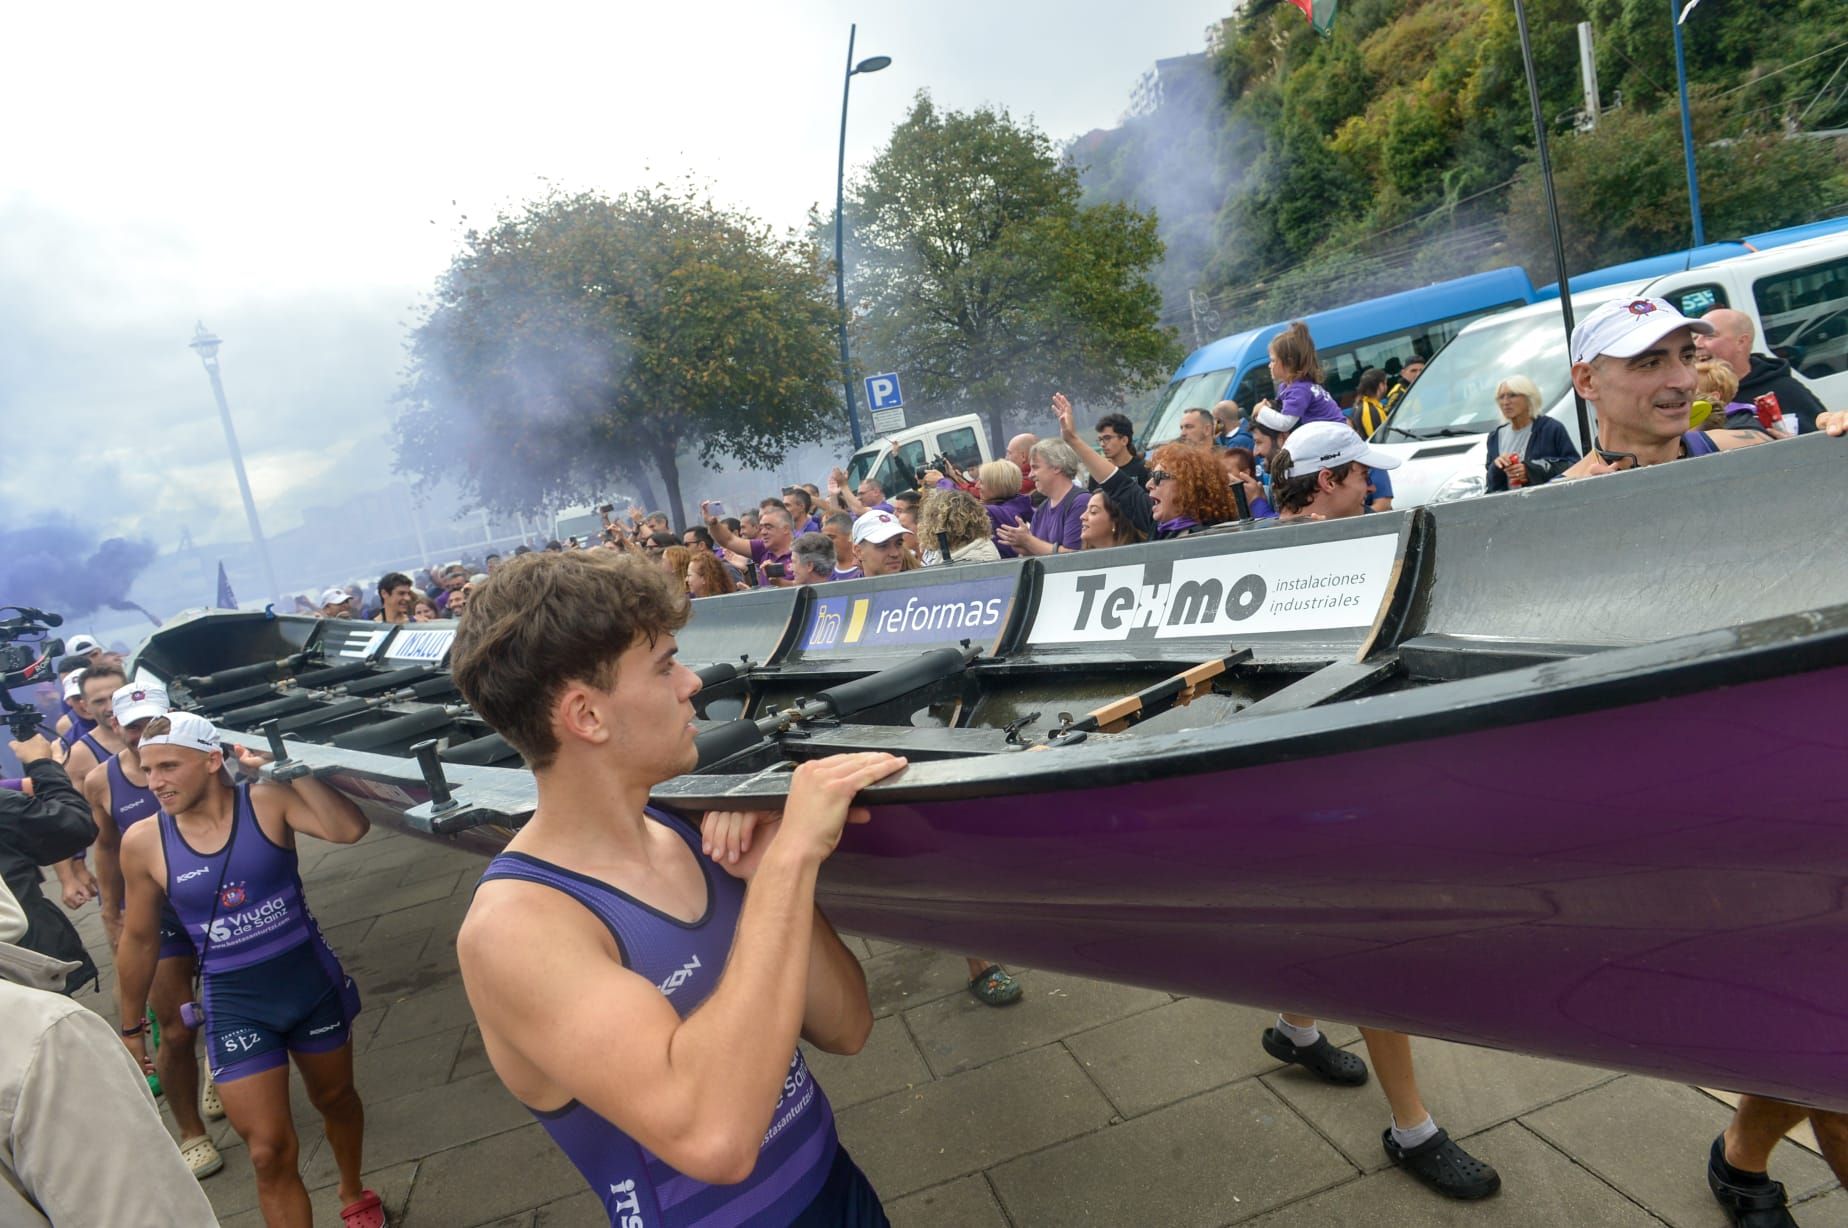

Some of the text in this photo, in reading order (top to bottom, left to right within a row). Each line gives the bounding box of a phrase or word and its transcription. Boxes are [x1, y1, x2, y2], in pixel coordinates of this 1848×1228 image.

[872, 379, 893, 407] P
[1275, 572, 1366, 592] instalaciones
[876, 597, 1002, 634] reformas
[1269, 593, 1361, 613] industriales
[394, 631, 454, 658] INSALUS
[233, 907, 289, 937] de Sainz
